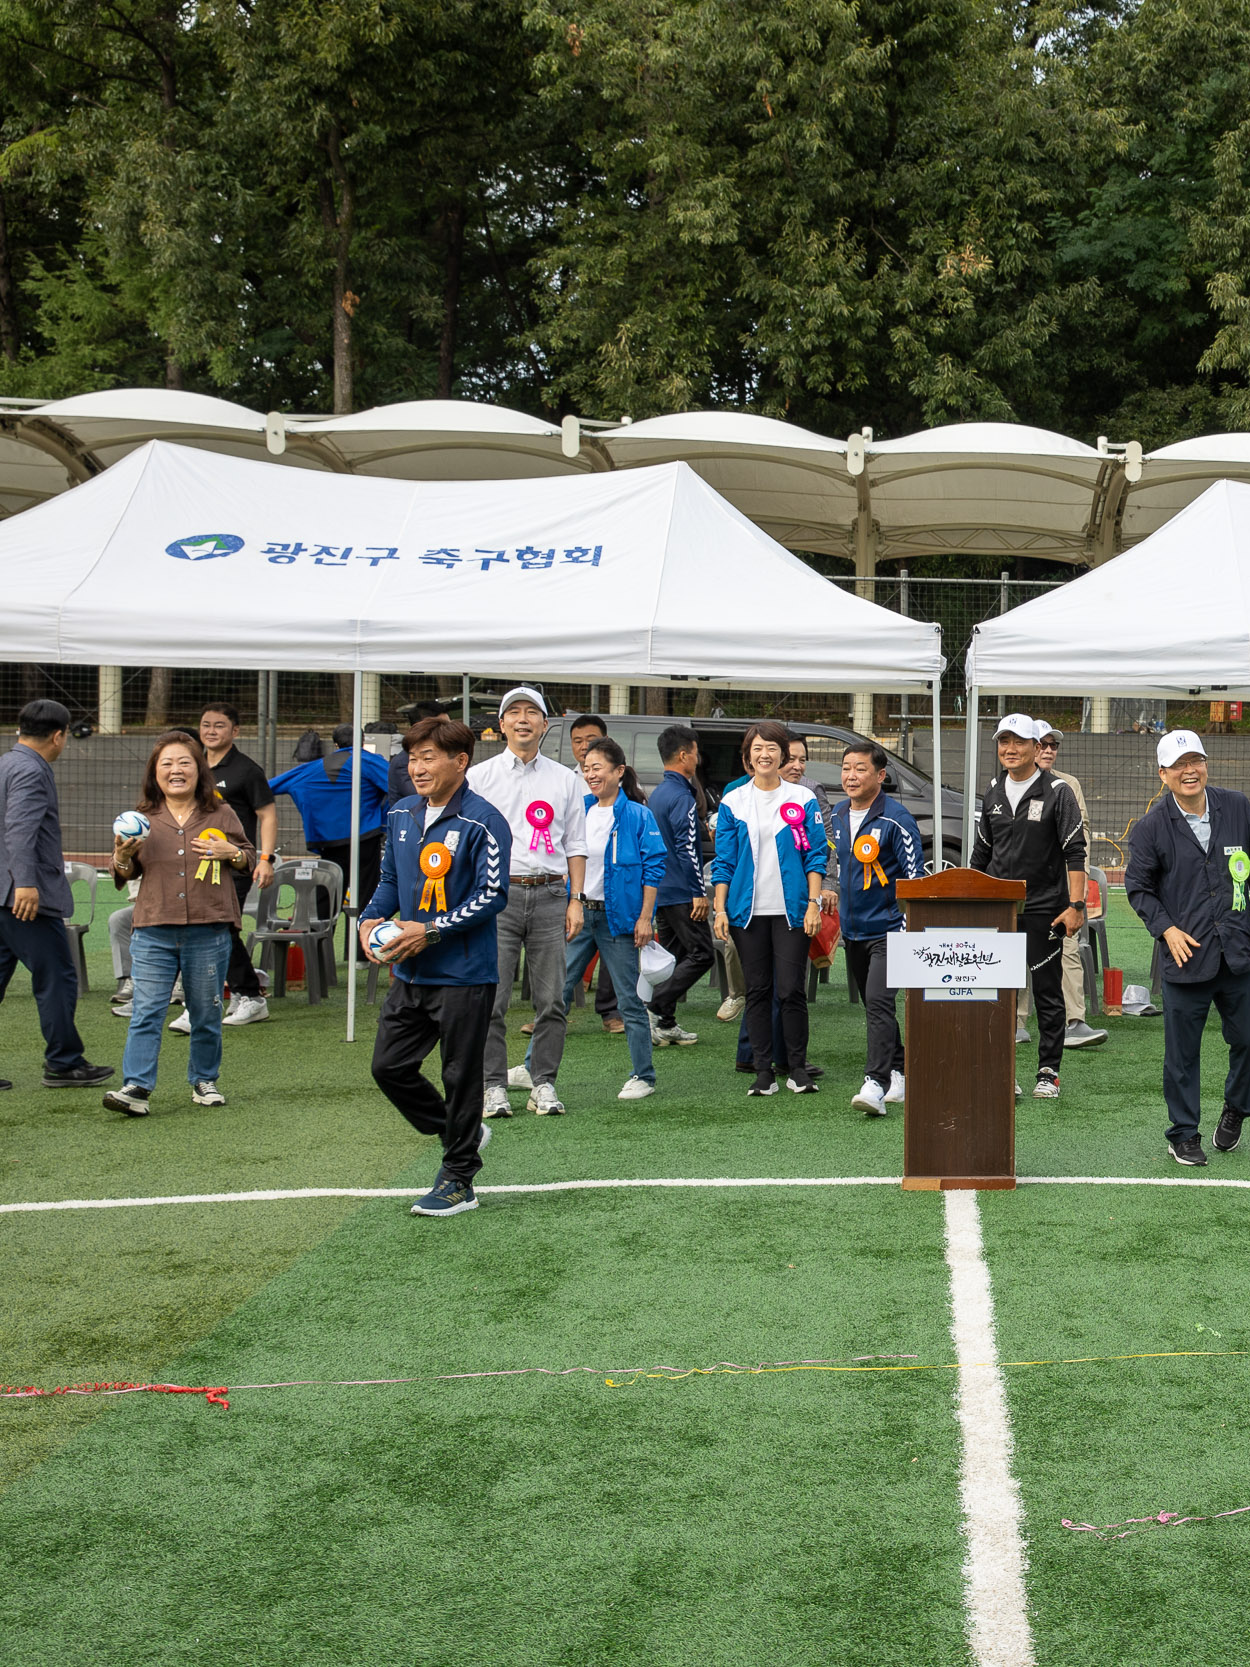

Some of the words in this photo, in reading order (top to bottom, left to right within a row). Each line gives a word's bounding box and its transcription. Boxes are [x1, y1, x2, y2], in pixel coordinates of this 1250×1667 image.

[260, 542, 400, 566] 광진구
[418, 545, 603, 571] 축구협회
[949, 988, 973, 996] GJFA
